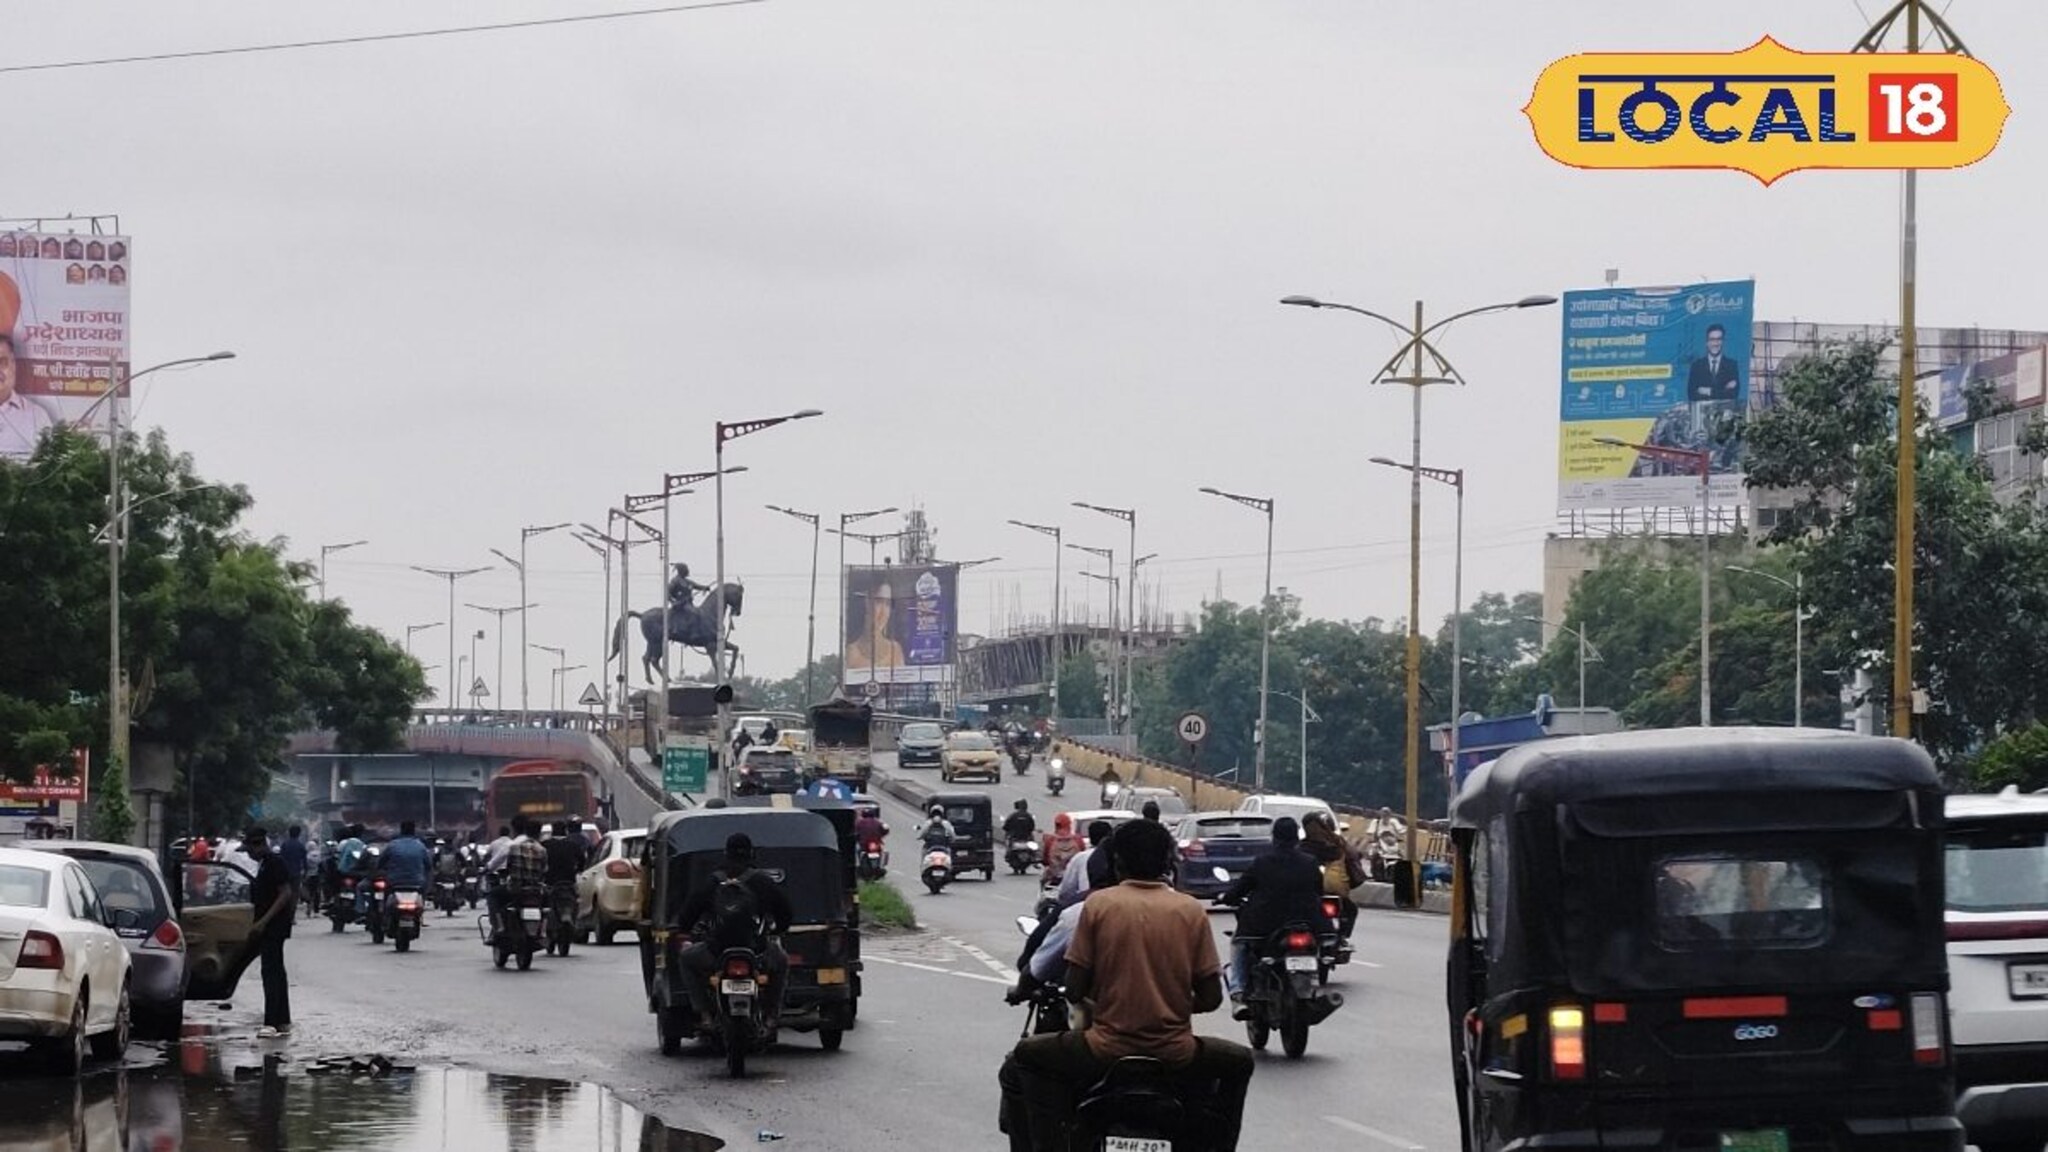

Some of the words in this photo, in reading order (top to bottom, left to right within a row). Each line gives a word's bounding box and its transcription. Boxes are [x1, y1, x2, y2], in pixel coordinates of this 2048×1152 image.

[62, 310, 123, 324] भाजपा
[24, 322, 122, 342] प्रदेशाध्यक्ष
[1184, 721, 1200, 734] 40
[1734, 1025, 1777, 1040] GOGO
